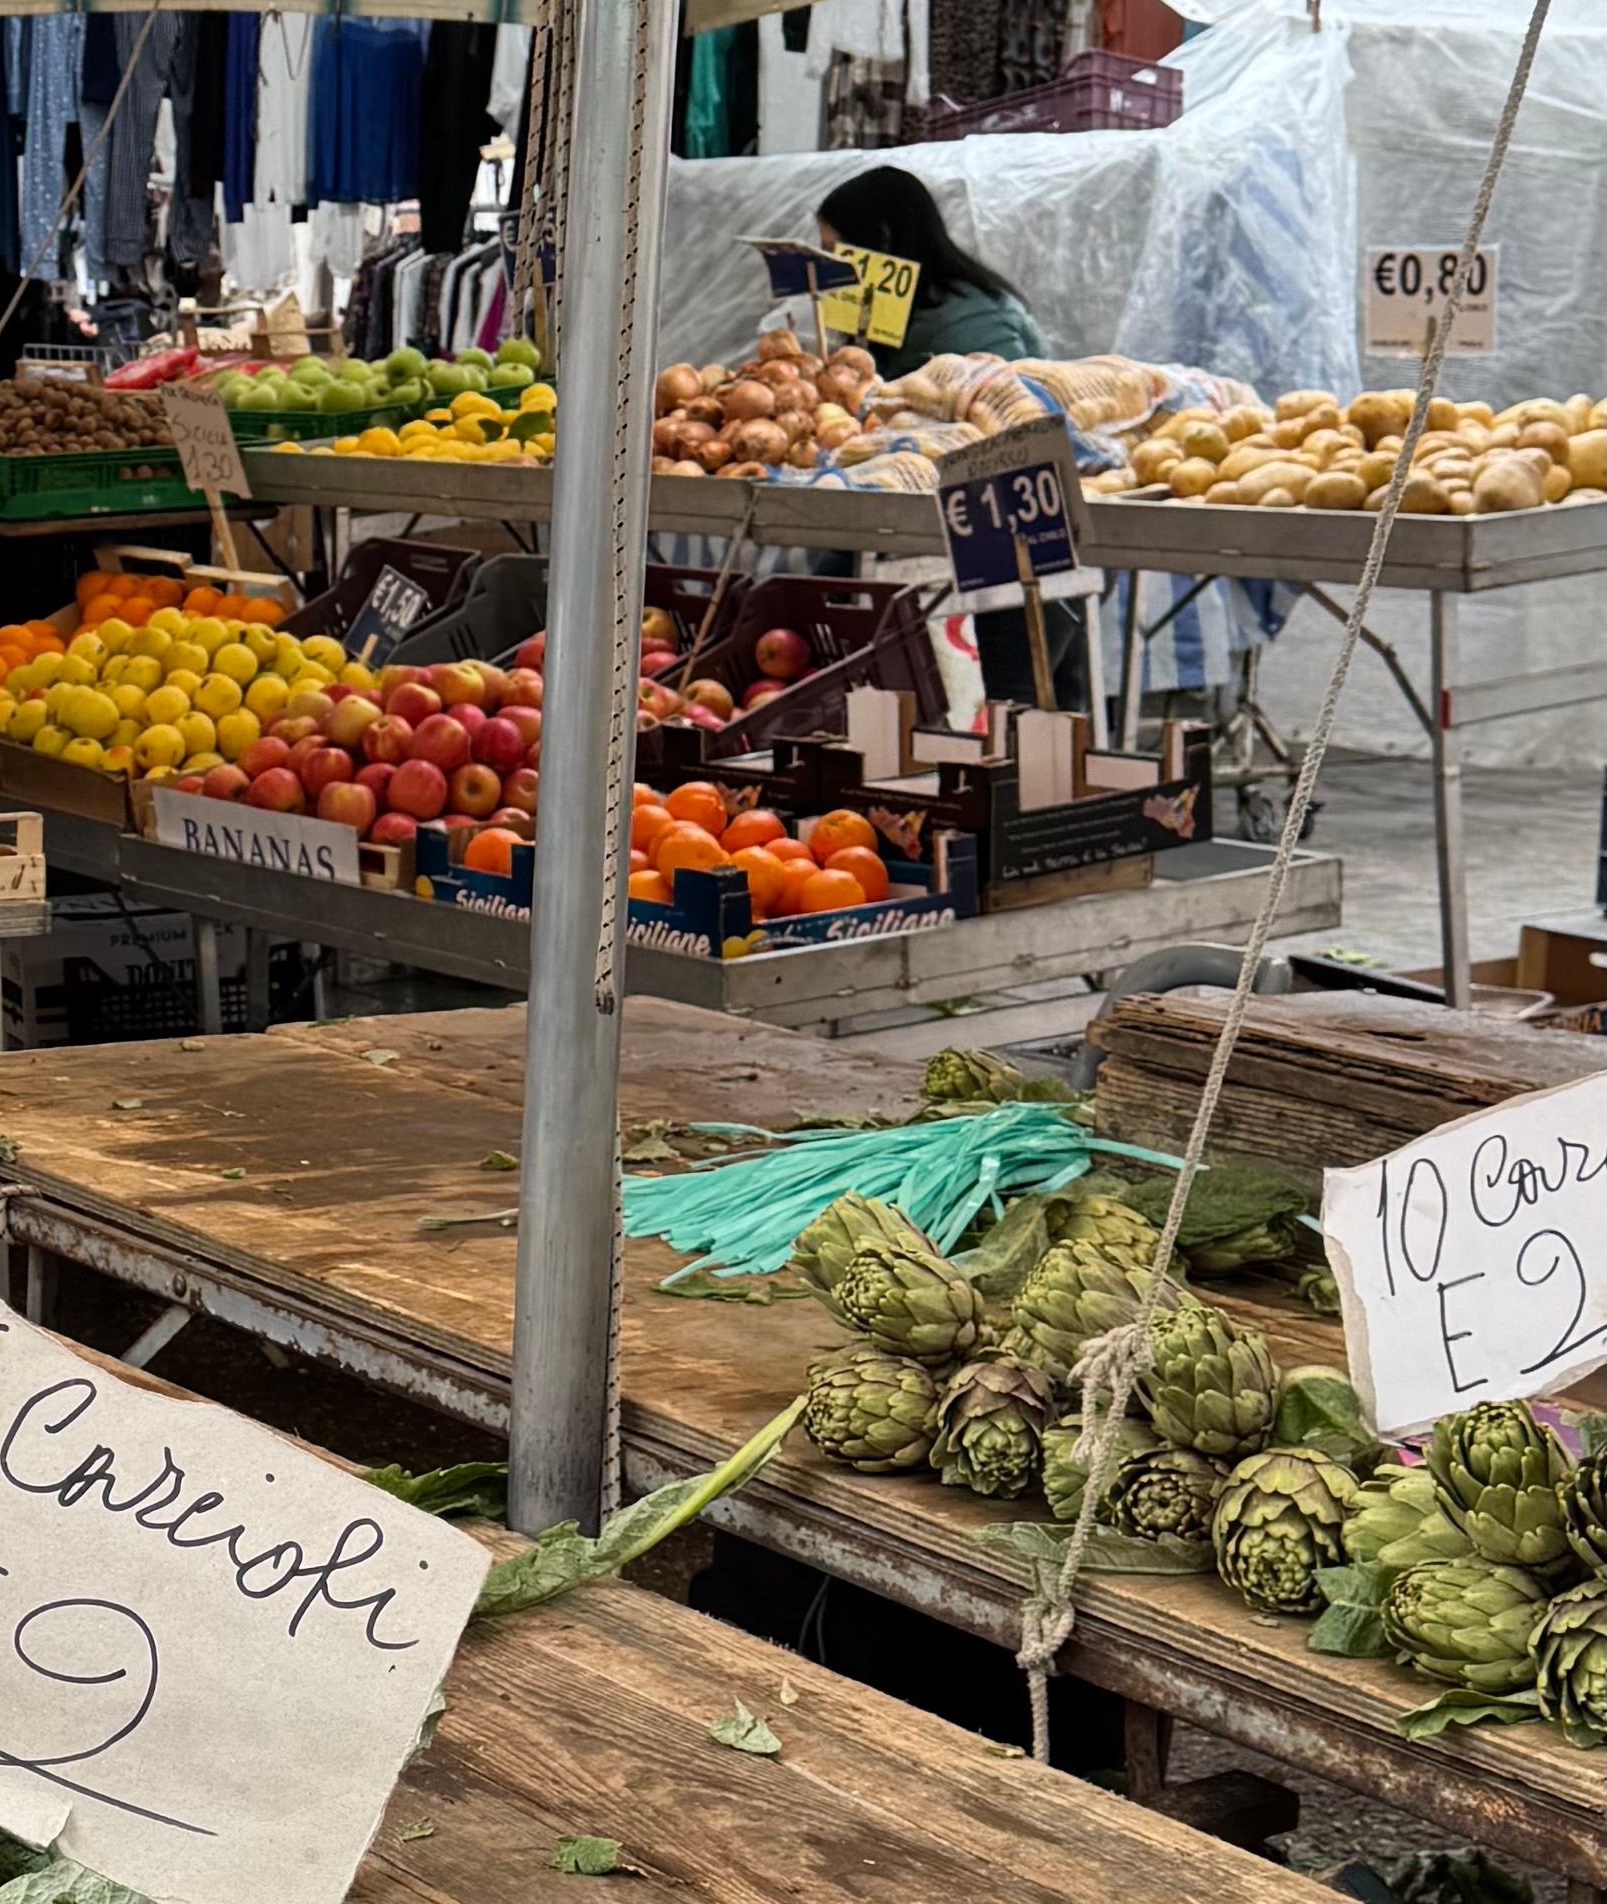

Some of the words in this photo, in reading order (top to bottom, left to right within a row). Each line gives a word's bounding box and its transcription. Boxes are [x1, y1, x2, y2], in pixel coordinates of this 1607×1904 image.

[1374, 253, 1487, 304] €0,80
[372, 574, 421, 628] €1,50
[181, 817, 335, 881] BANANAS
[1376, 1158, 1448, 1297] 10
[1470, 1134, 1607, 1228] Car
[0, 1376, 430, 1652] Carciofi
